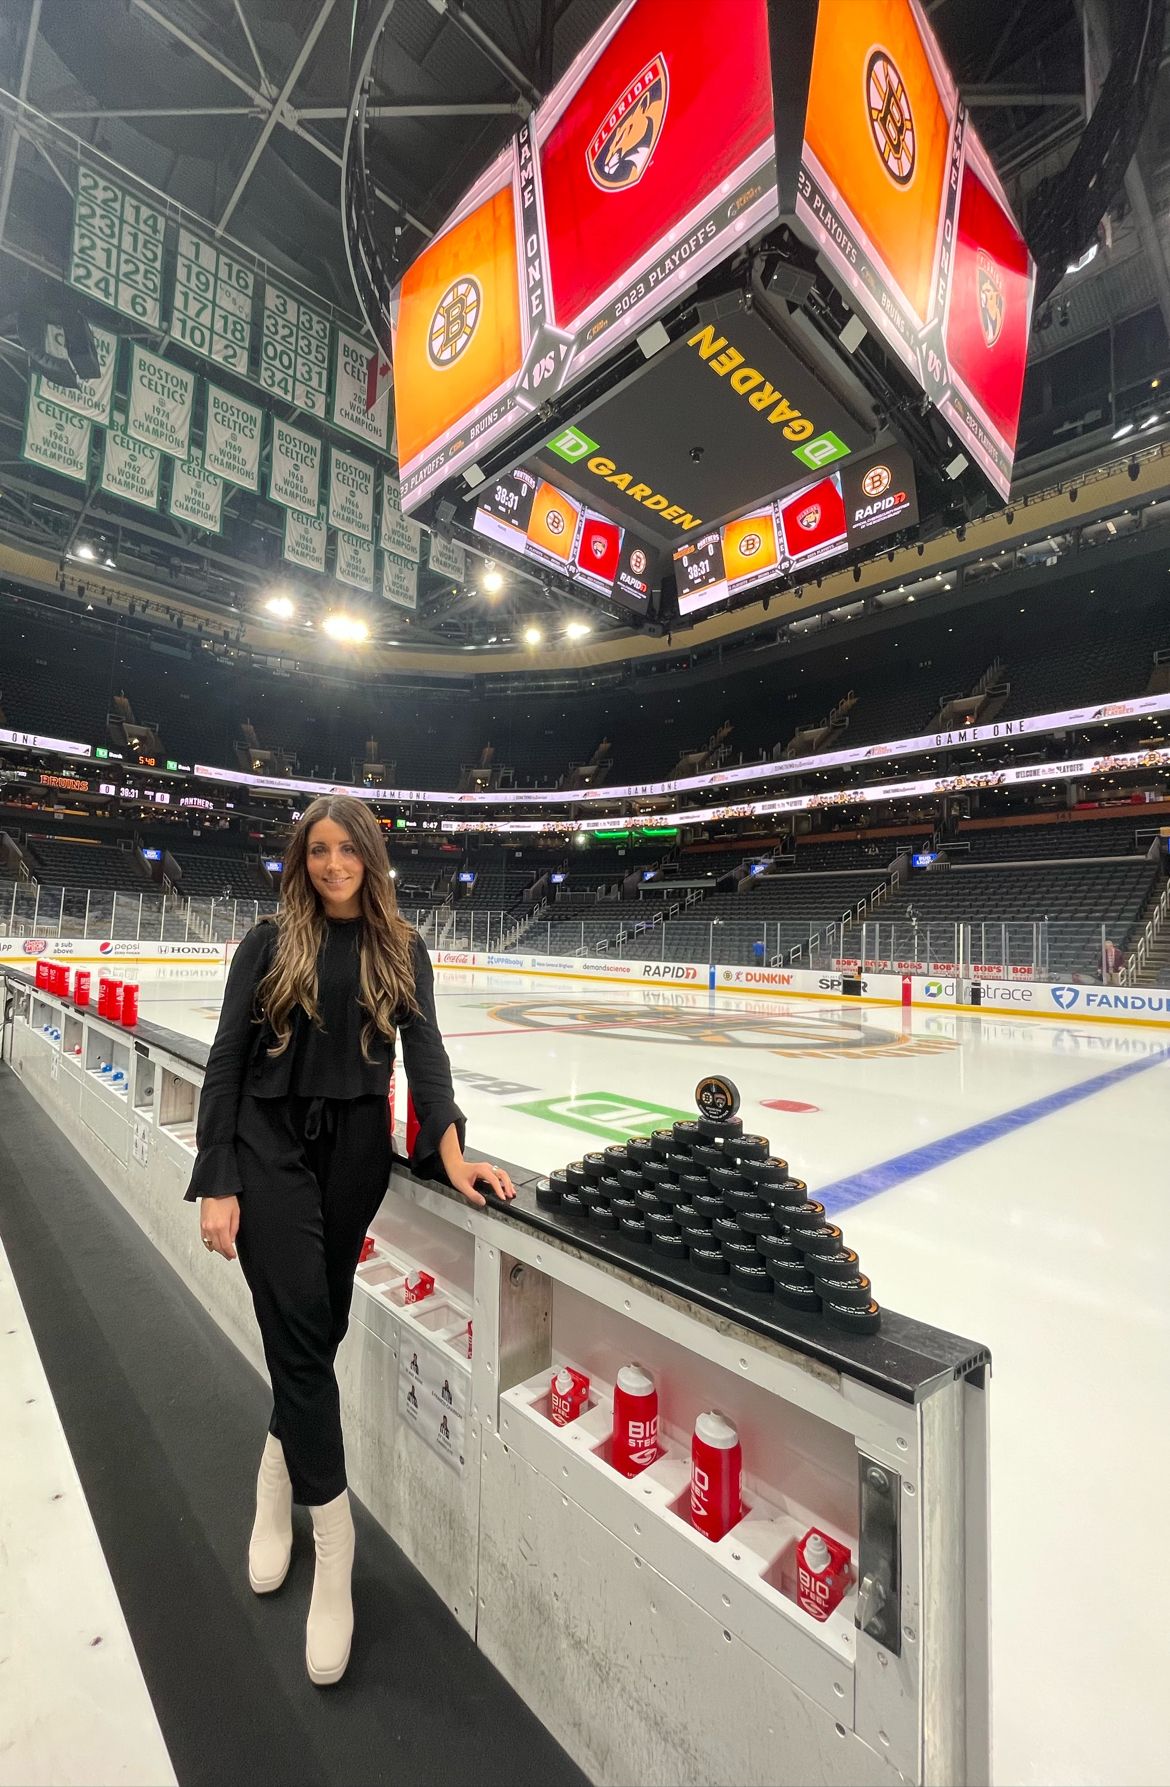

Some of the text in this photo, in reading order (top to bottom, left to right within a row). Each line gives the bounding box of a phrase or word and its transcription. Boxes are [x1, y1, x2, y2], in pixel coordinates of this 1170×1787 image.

[591, 70, 655, 159] FLORIDA
[518, 124, 534, 210] GAME
[81, 172, 119, 206] 22
[77, 203, 117, 241] 23
[130, 203, 161, 238] 14
[812, 193, 858, 264] PLAYOFFS
[77, 233, 114, 271] 21
[128, 231, 161, 264] 15
[191, 240, 202, 263] 1
[72, 261, 114, 300] 24
[123, 258, 160, 295] 25
[181, 262, 210, 294] 19
[221, 261, 251, 290] 16
[524, 237, 543, 318] ONE
[615, 220, 717, 318] 2023 PLAYOFFS
[130, 293, 149, 319] 6
[179, 290, 210, 319] 17
[274, 294, 289, 316] 3
[177, 318, 206, 349] 10
[220, 313, 247, 344] 18
[265, 314, 295, 344] 32
[301, 308, 329, 341] 33
[222, 343, 238, 368] 2
[264, 340, 294, 372] 00
[300, 333, 327, 365] 35
[138, 359, 190, 393] BOSTON
[263, 368, 291, 396] 34
[300, 361, 324, 388] 31
[686, 323, 816, 442] GARDEN
[139, 374, 186, 407] CELTICS
[303, 386, 317, 410] 5
[37, 400, 85, 431] CELTICS
[144, 412, 177, 435] WORLD
[212, 396, 257, 428] BOSTON
[214, 411, 255, 441] CELTICS
[339, 408, 383, 438] CHAMPIONS
[469, 410, 499, 440] BRUINS
[42, 436, 75, 458] WORLD
[113, 432, 156, 462] CELTICS
[132, 418, 185, 450] CHAMPIONS
[277, 428, 318, 459] BOSTON
[30, 442, 86, 472] CHAMPIONS
[208, 453, 256, 482] CHAMPIONS
[219, 447, 248, 469] WORLD
[278, 442, 316, 470] CELTICS
[117, 467, 148, 487] WORLD
[179, 461, 219, 488] CELTICS
[334, 458, 371, 485] BOSTON
[335, 471, 370, 497] CELTICS
[410, 456, 445, 489] PLAYOFFS
[106, 473, 155, 500] CHAMPIONS
[274, 482, 316, 508] CHAMPIONS
[283, 476, 310, 496] WORLD
[494, 485, 519, 511] 38:31
[587, 456, 703, 531] GARDEN
[174, 499, 218, 524] CHAMPIONS
[183, 494, 212, 513] WORLD
[339, 503, 364, 522] WORLD
[687, 559, 710, 580] 38:31
[12, 732, 39, 746] ONE
[936, 720, 1025, 746] GAME ONE
[40, 774, 89, 792] BRUINS
[119, 787, 139, 799] 38:31
[376, 789, 428, 801] GAME ONE
[628, 781, 679, 796] GAME ONE
[180, 797, 214, 810] PANTHERS
[114, 943, 140, 954] pepsi
[171, 946, 220, 955] HONDA
[582, 963, 631, 973] demandscience
[643, 965, 697, 980] RAPID7
[745, 972, 793, 985] DUNKIN'
[973, 965, 1002, 973] BOB'S
[551, 1392, 570, 1413] BIO
[798, 1566, 830, 1600] BIO
